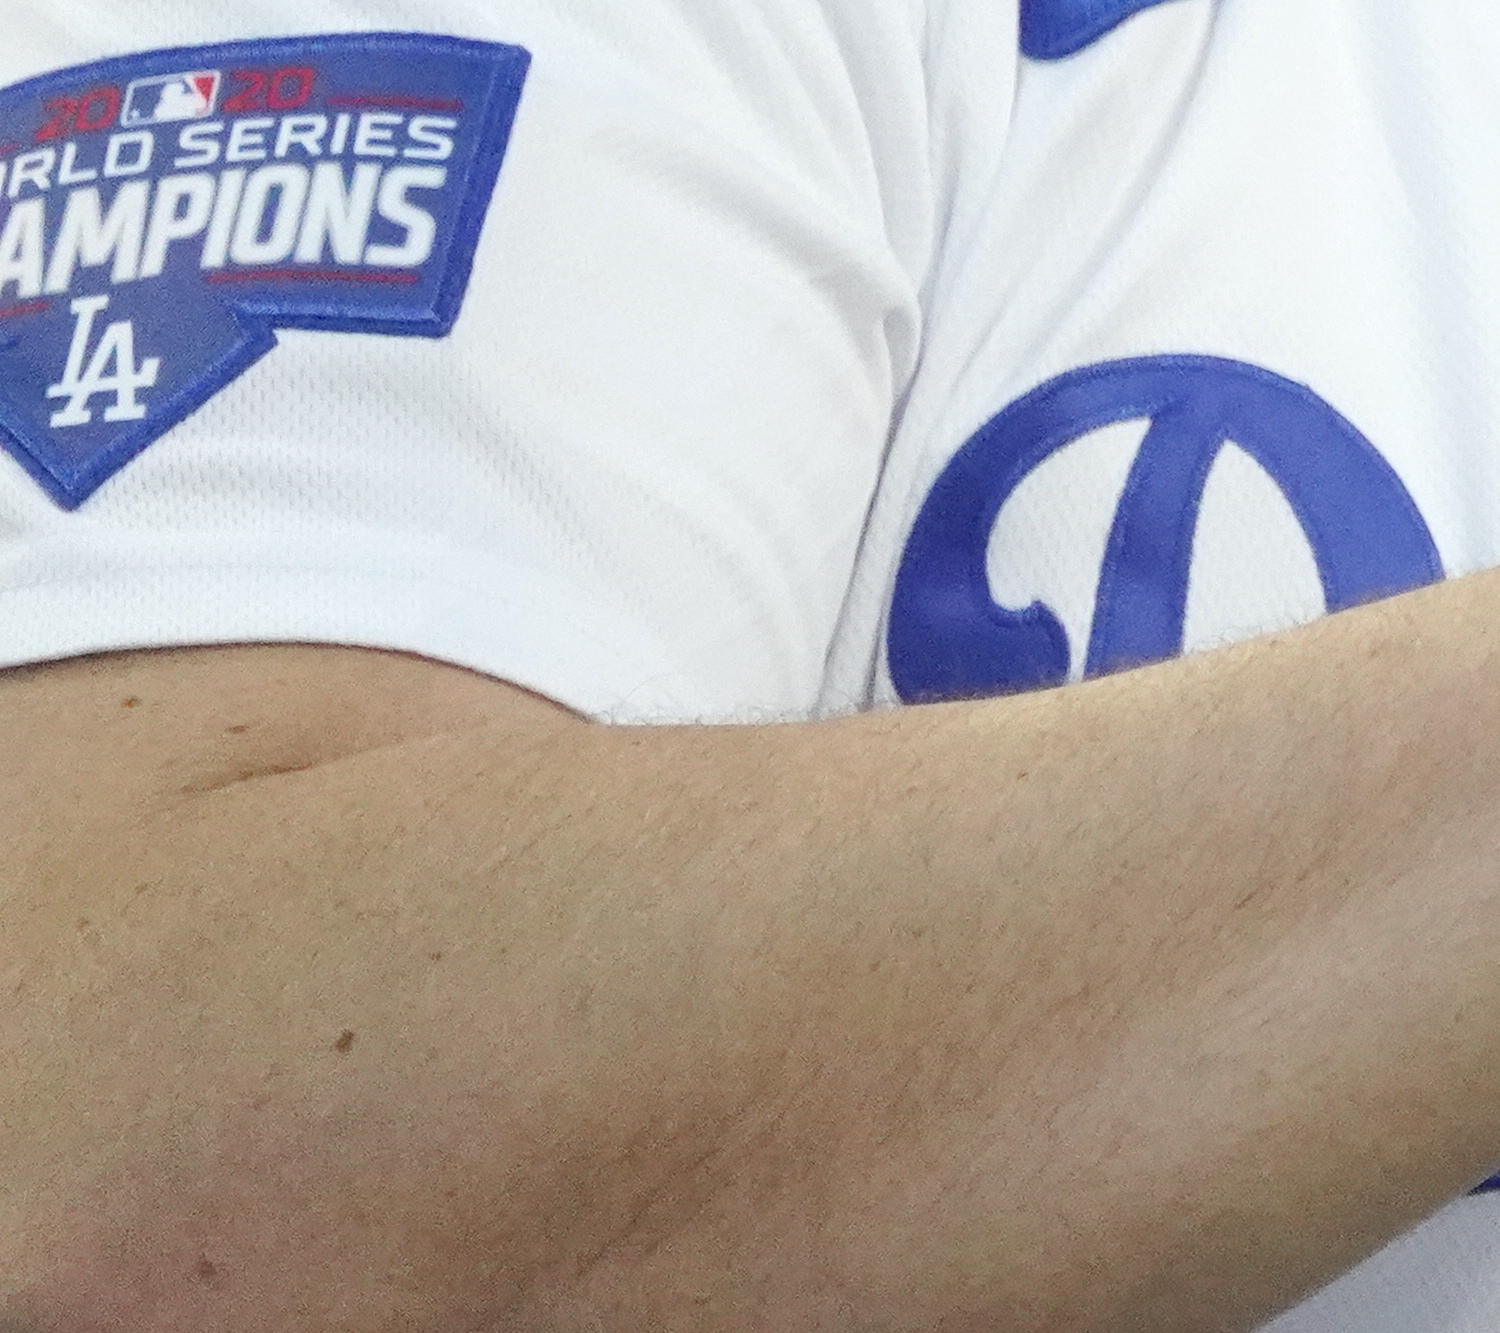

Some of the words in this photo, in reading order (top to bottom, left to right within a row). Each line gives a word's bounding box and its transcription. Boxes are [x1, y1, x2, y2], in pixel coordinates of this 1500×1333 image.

[0, 129, 154, 199] RLD
[174, 112, 458, 169] SERIES
[35, 85, 122, 142] 20
[222, 65, 315, 114] 20
[0, 161, 447, 299] AMPIONS
[46, 295, 161, 428] LA
